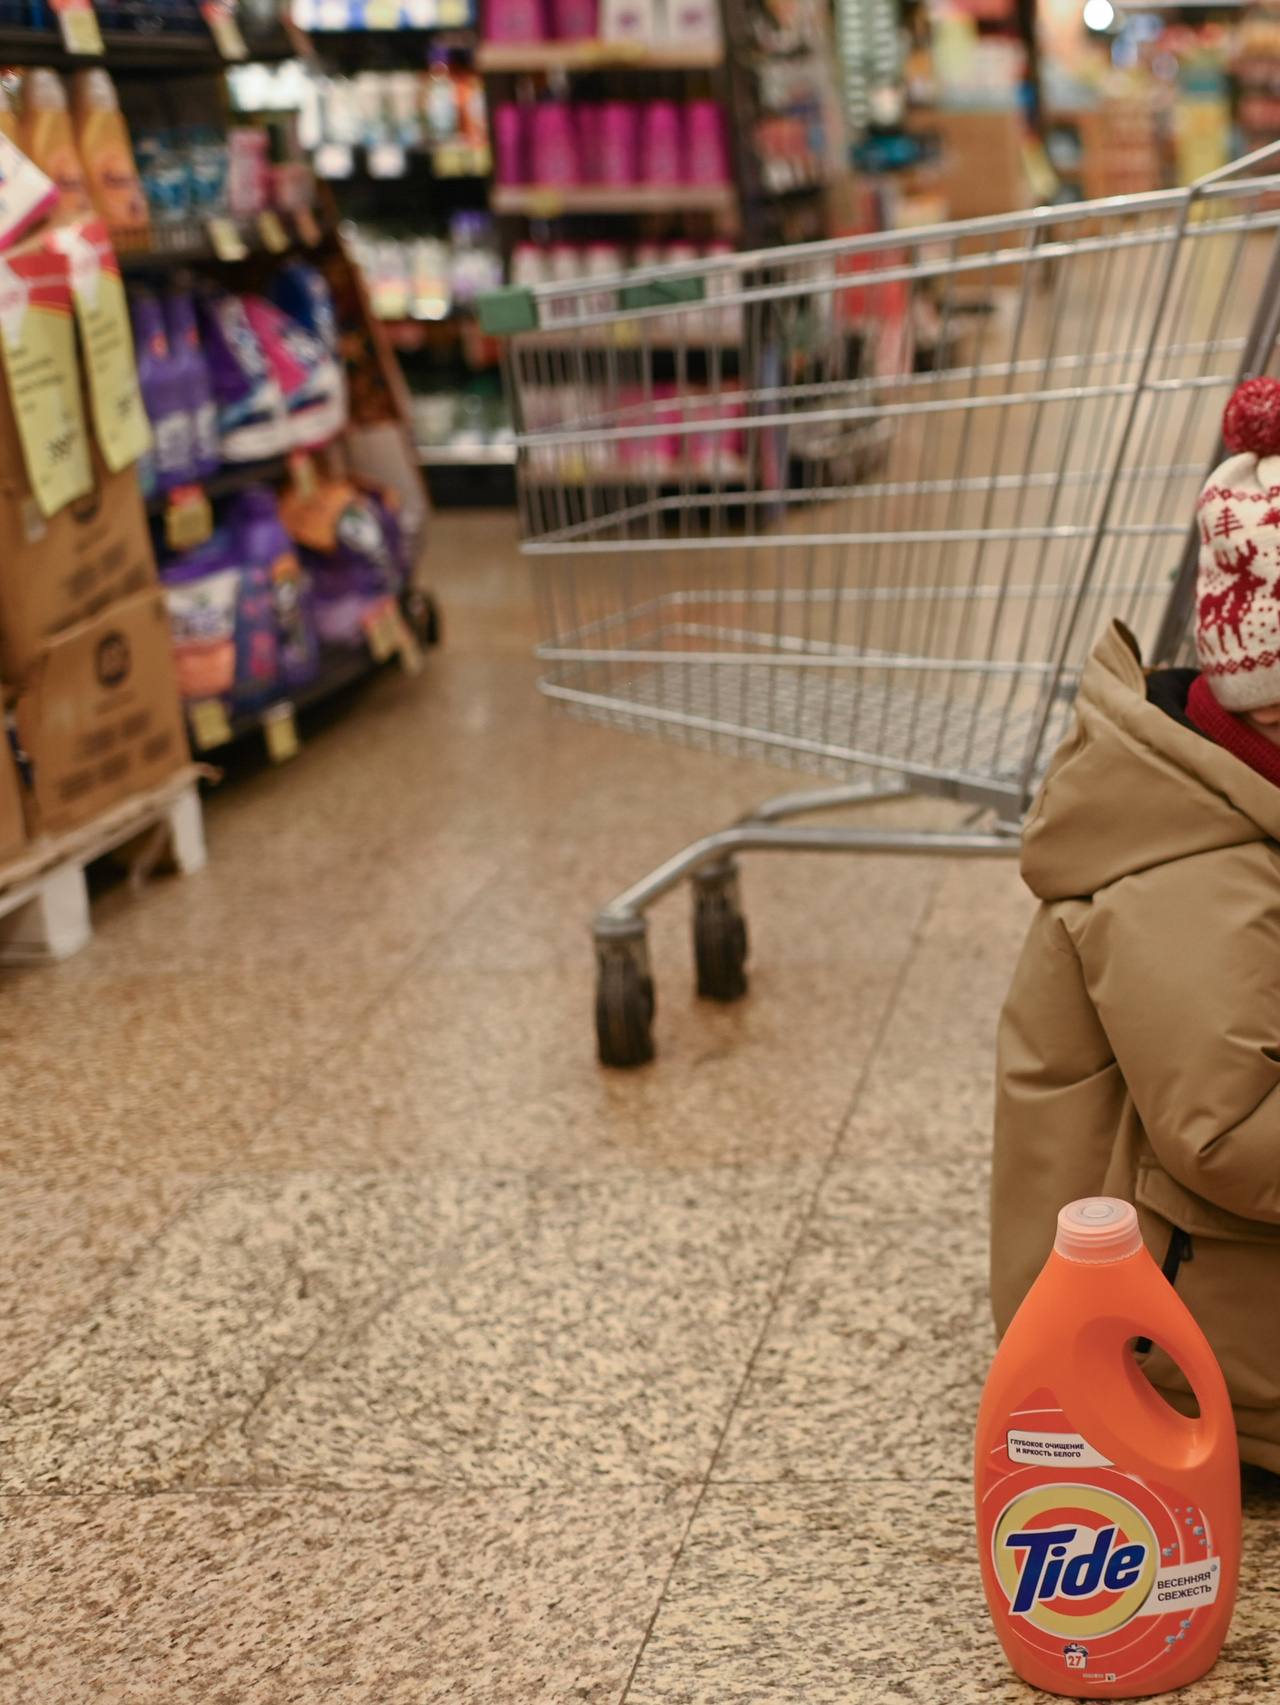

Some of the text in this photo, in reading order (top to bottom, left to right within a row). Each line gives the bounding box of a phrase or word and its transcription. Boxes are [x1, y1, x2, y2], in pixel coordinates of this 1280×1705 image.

[1010, 1438, 1085, 1450] ГЛУБОКОЕ ОЧИЩЕНИЕ
[1022, 1448, 1052, 1457] ЯРКОСТЬ
[1005, 1526, 1147, 1613] Tide
[1157, 1571, 1212, 1590] ВЕСЕННЯЯ
[1157, 1584, 1212, 1602] СВЕЖЕСТЬ
[1068, 1655, 1082, 1667] 27
